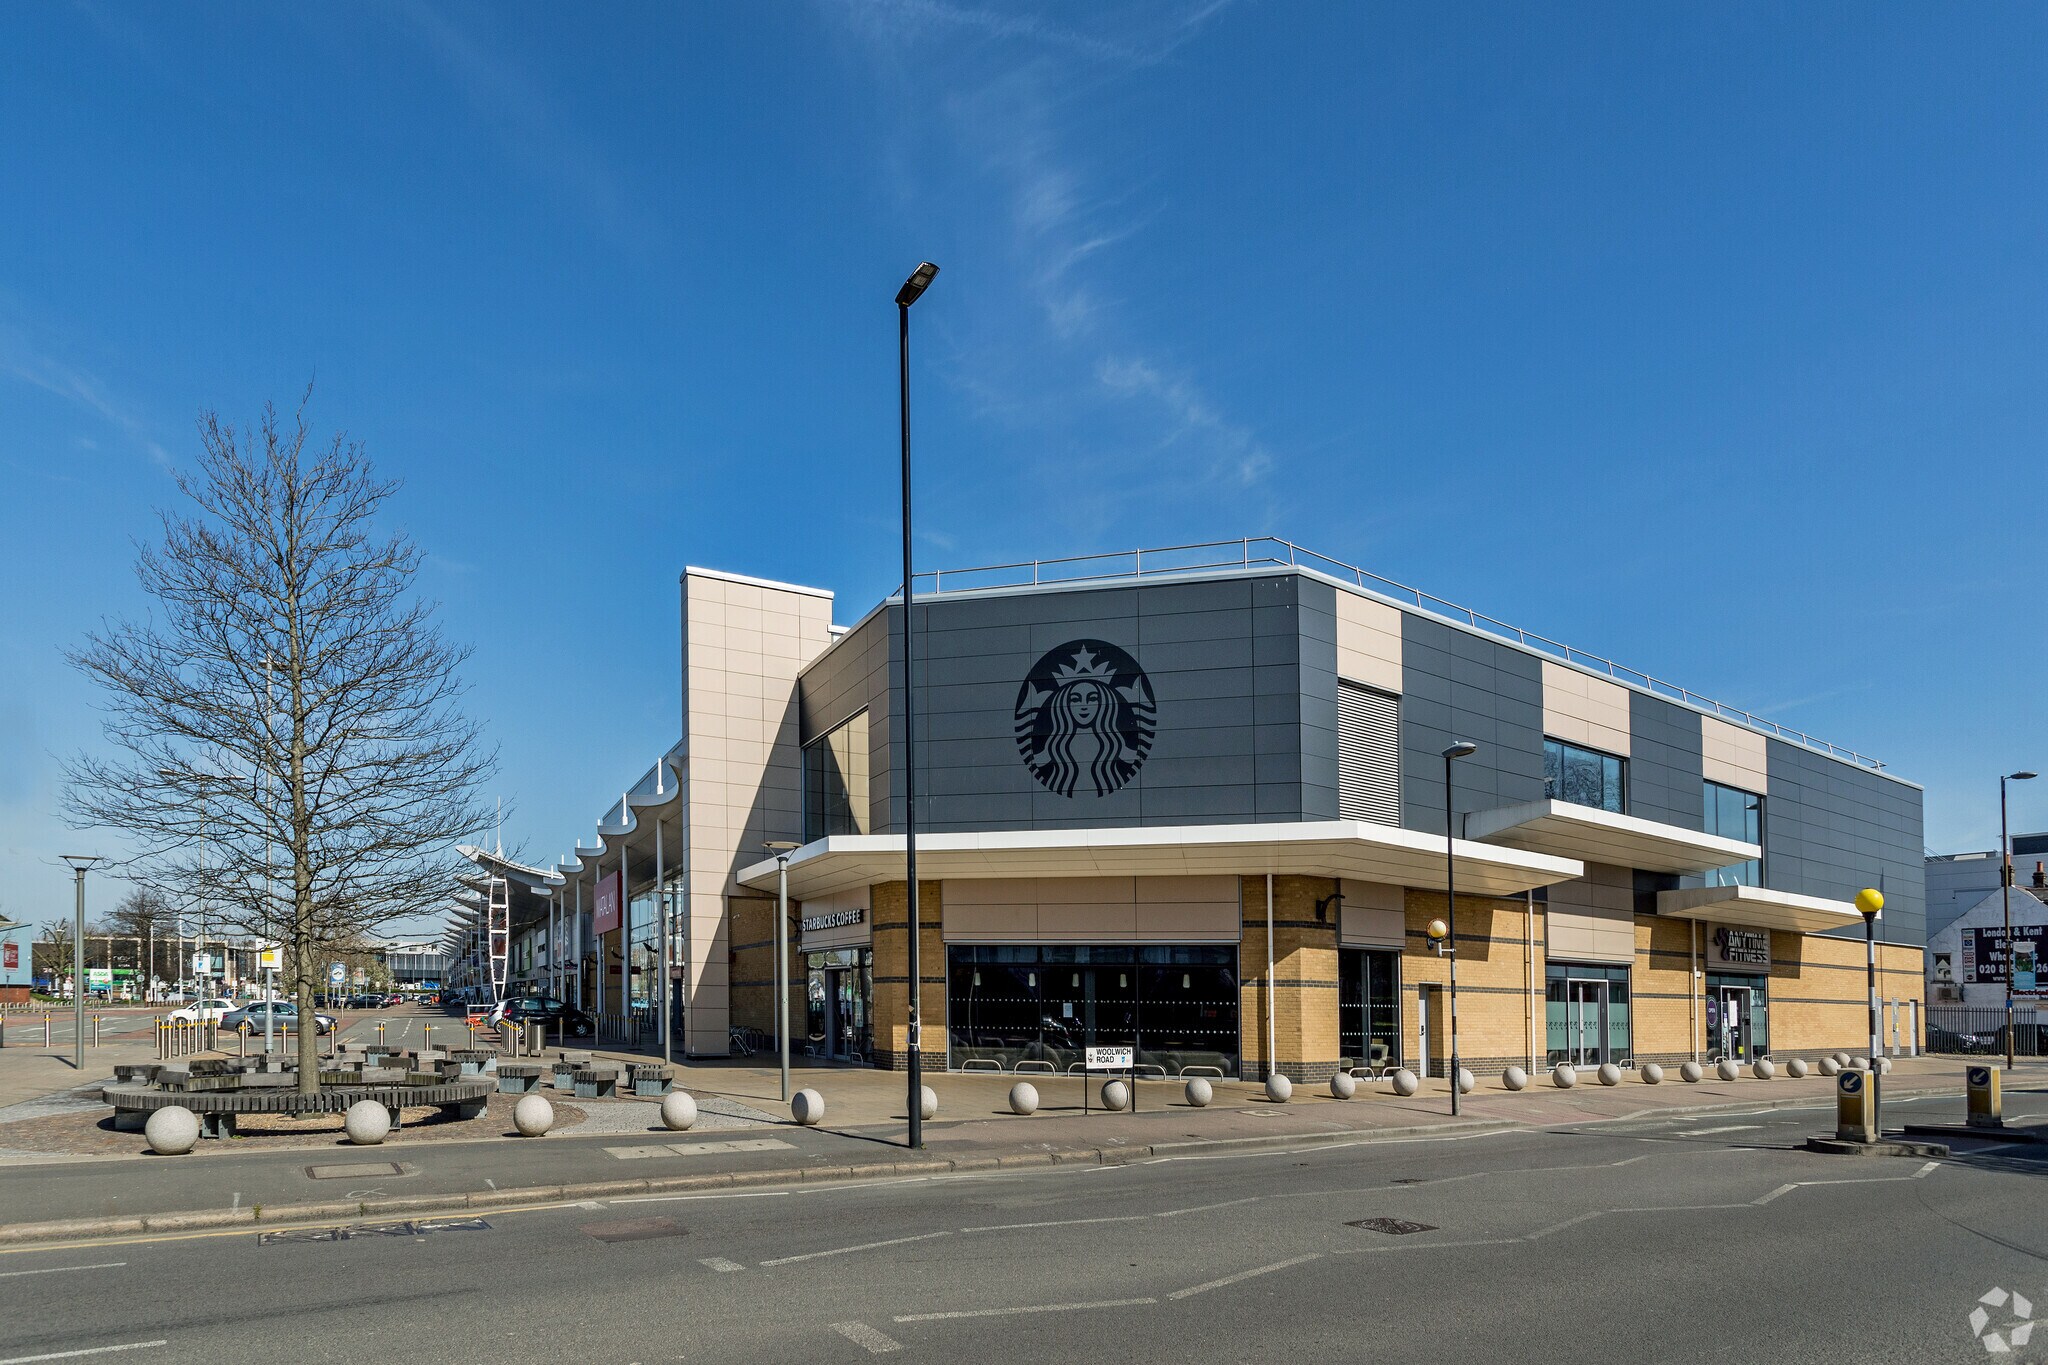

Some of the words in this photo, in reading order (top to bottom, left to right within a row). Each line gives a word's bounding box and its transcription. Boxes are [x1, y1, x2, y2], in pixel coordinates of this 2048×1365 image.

[802, 913, 835, 931] STARBUCKS
[836, 909, 861, 926] COFFEE
[2013, 926, 2021, 937] &
[2023, 926, 2043, 936] Kent
[1728, 930, 1768, 950] ANYTIME
[1729, 947, 1769, 963] FITNESS
[1979, 964, 1996, 974] 020
[1096, 1047, 1132, 1056] WOOLWICH
